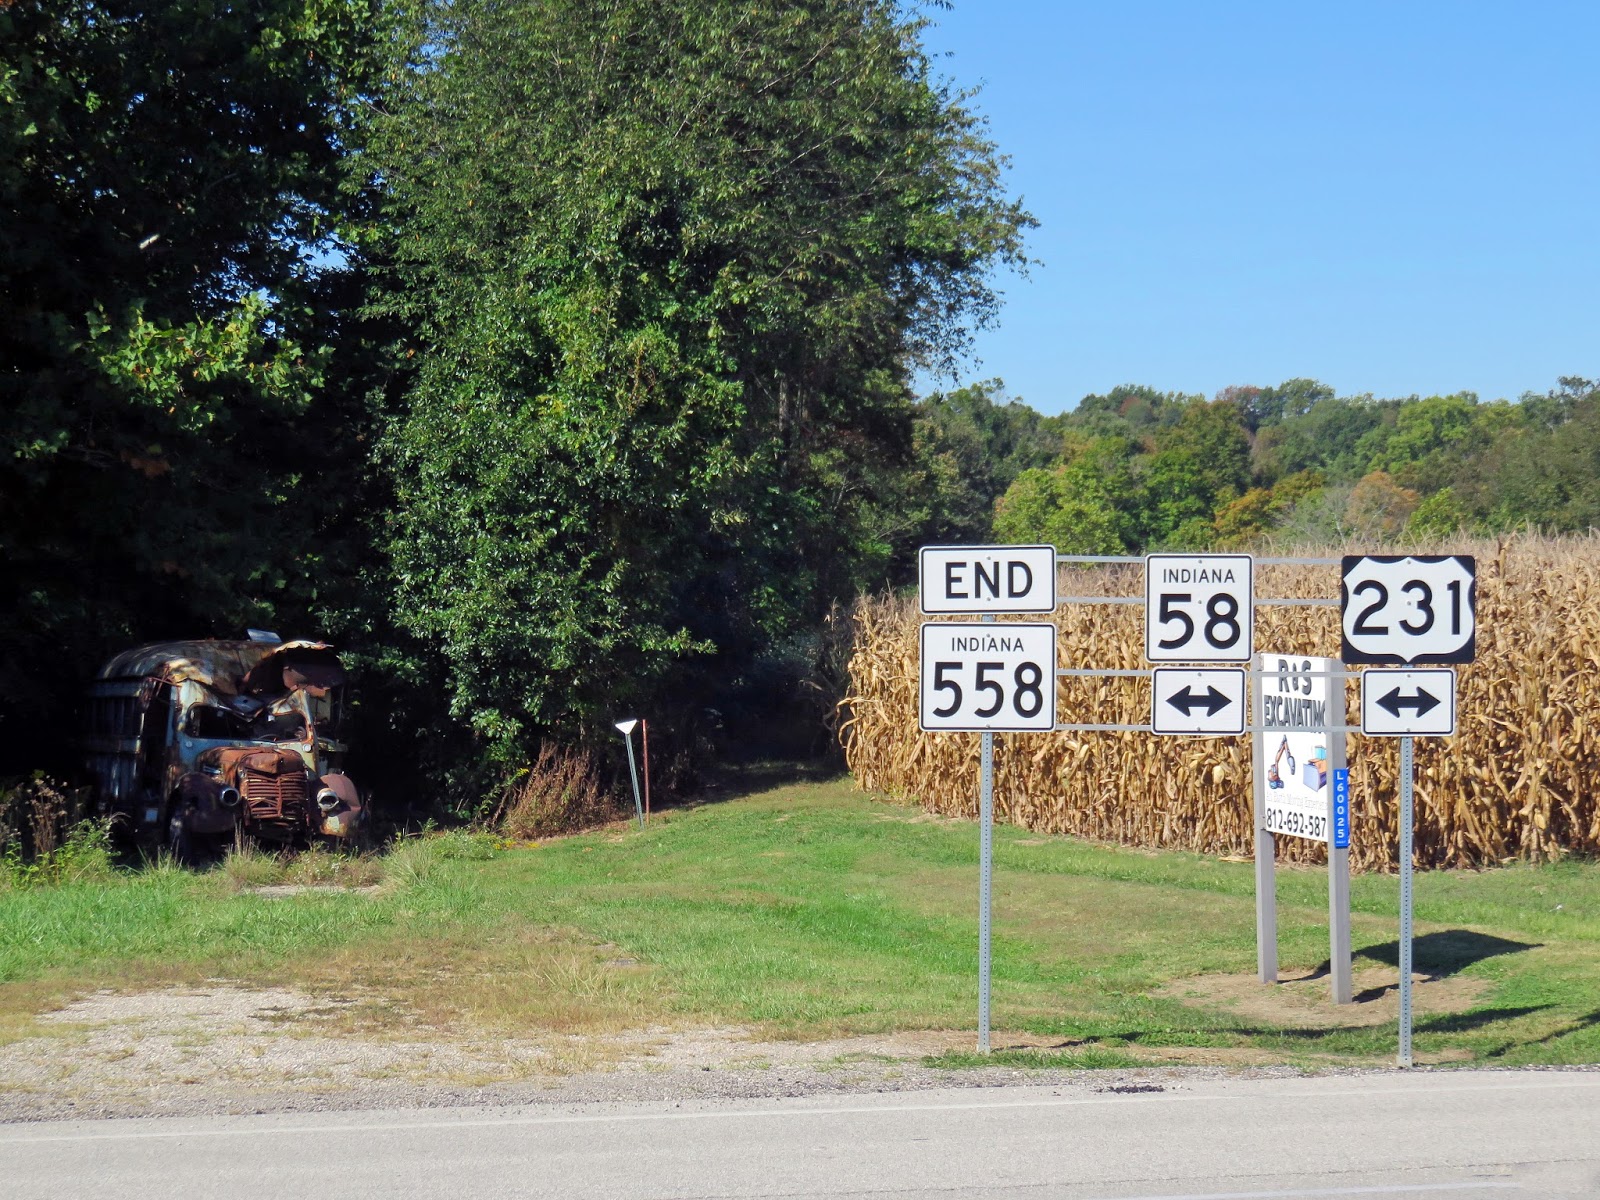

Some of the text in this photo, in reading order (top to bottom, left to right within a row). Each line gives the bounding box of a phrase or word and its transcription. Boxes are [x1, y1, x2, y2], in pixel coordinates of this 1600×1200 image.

[945, 561, 1033, 599] END
[1163, 568, 1235, 583] INDIANA
[1158, 592, 1240, 649] 58
[1352, 579, 1461, 636] 231
[952, 637, 1024, 652] INDIANA
[932, 661, 1043, 718] 558
[1266, 807, 1327, 838] 812-692-587
[1336, 771, 1345, 838] L60025
